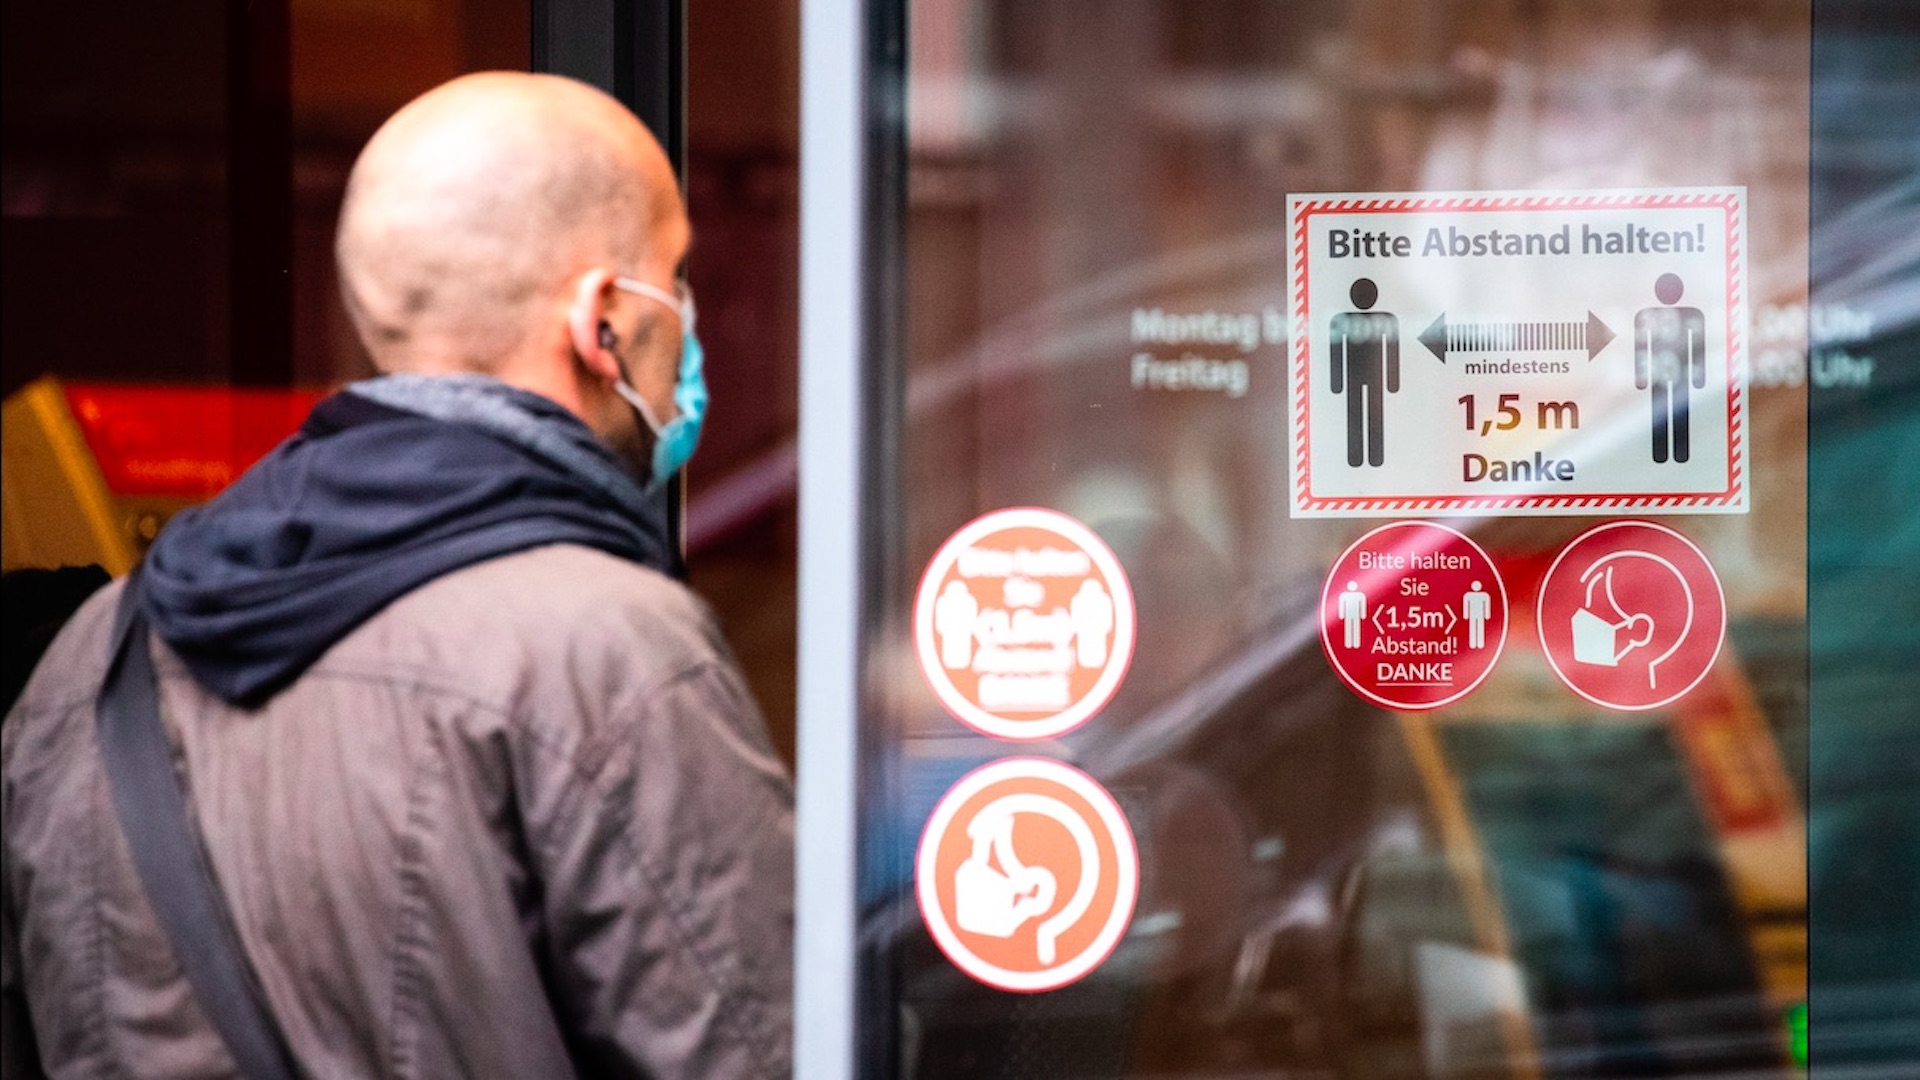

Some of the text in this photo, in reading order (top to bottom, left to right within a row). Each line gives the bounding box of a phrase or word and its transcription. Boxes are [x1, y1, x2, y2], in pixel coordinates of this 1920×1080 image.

[1328, 223, 1706, 258] Bitte Abstand halten!
[1132, 309, 1259, 351] Montag
[1132, 354, 1248, 396] Freitag
[1465, 359, 1570, 374] mindestens
[1458, 394, 1579, 437] 1,5 m
[1463, 452, 1575, 482] Danke
[1359, 551, 1470, 570] Bitte halten
[1400, 577, 1429, 596] Sie
[1371, 636, 1458, 655] Abstand!
[1376, 662, 1453, 681] DANKE
